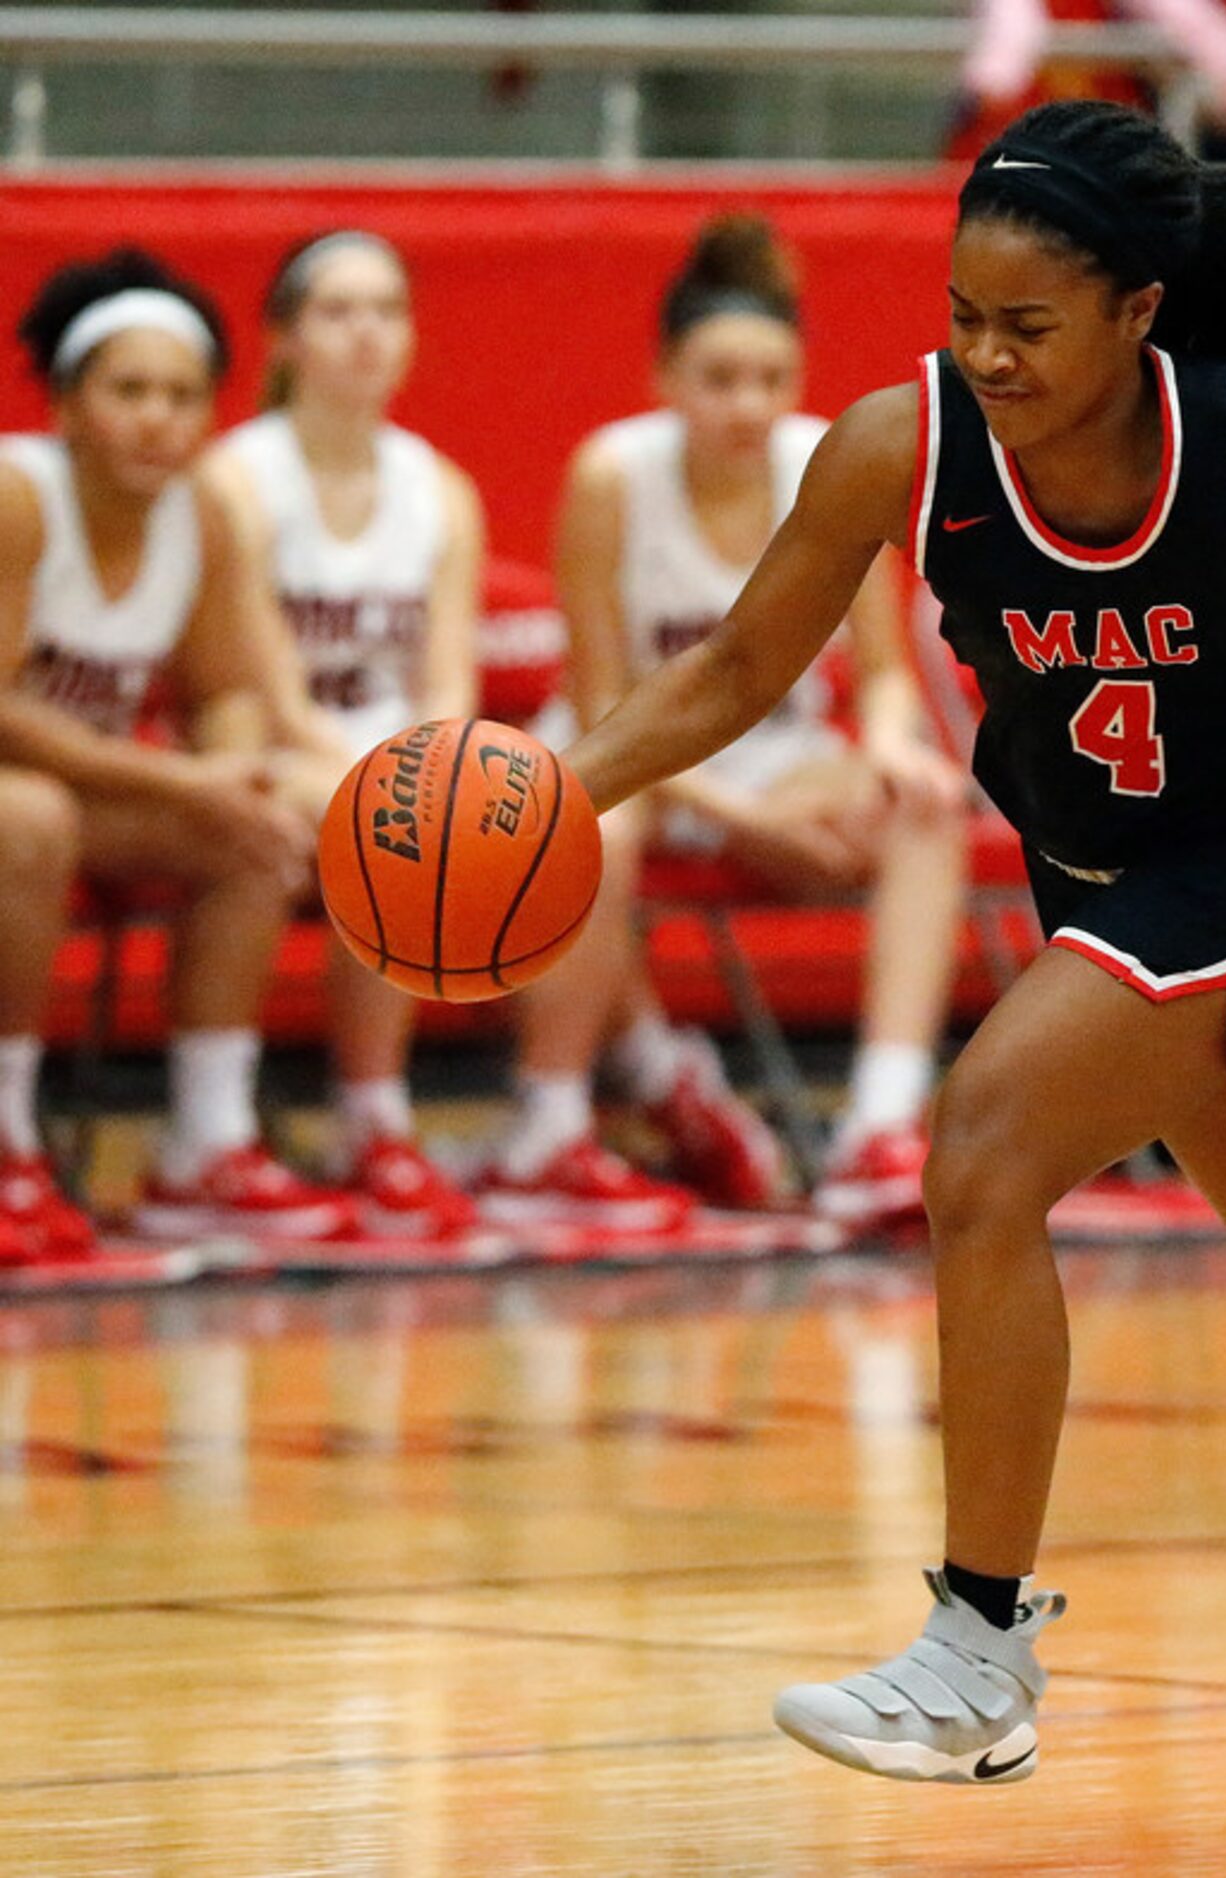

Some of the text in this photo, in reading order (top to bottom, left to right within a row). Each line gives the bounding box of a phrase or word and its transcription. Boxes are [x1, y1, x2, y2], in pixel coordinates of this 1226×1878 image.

[1001, 603, 1199, 675] MAC
[1068, 678, 1166, 798] 4
[495, 747, 532, 838] ELITE
